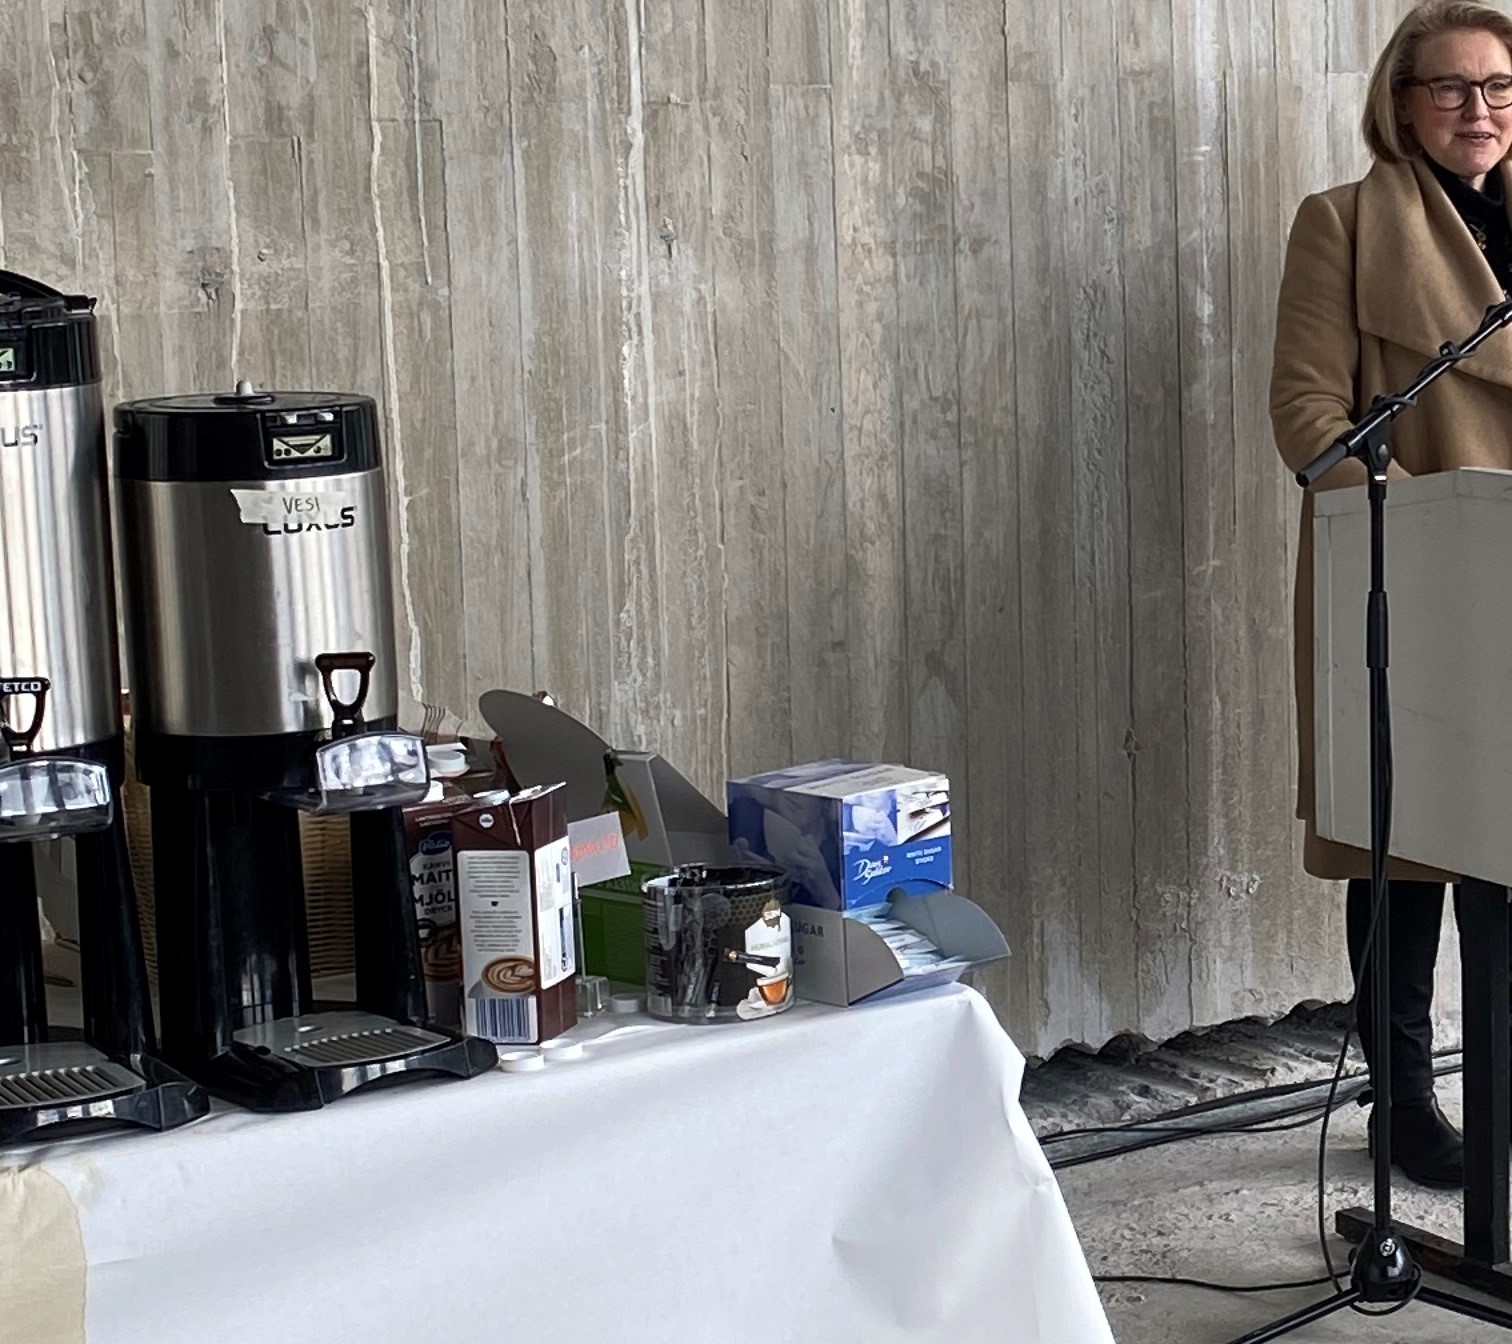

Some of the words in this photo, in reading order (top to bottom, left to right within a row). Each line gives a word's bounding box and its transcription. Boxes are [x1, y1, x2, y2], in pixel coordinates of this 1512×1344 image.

[282, 496, 321, 514] VESI
[411, 869, 453, 885] MAIT
[414, 889, 456, 907] MJÖL
[794, 921, 824, 937] UGAR
